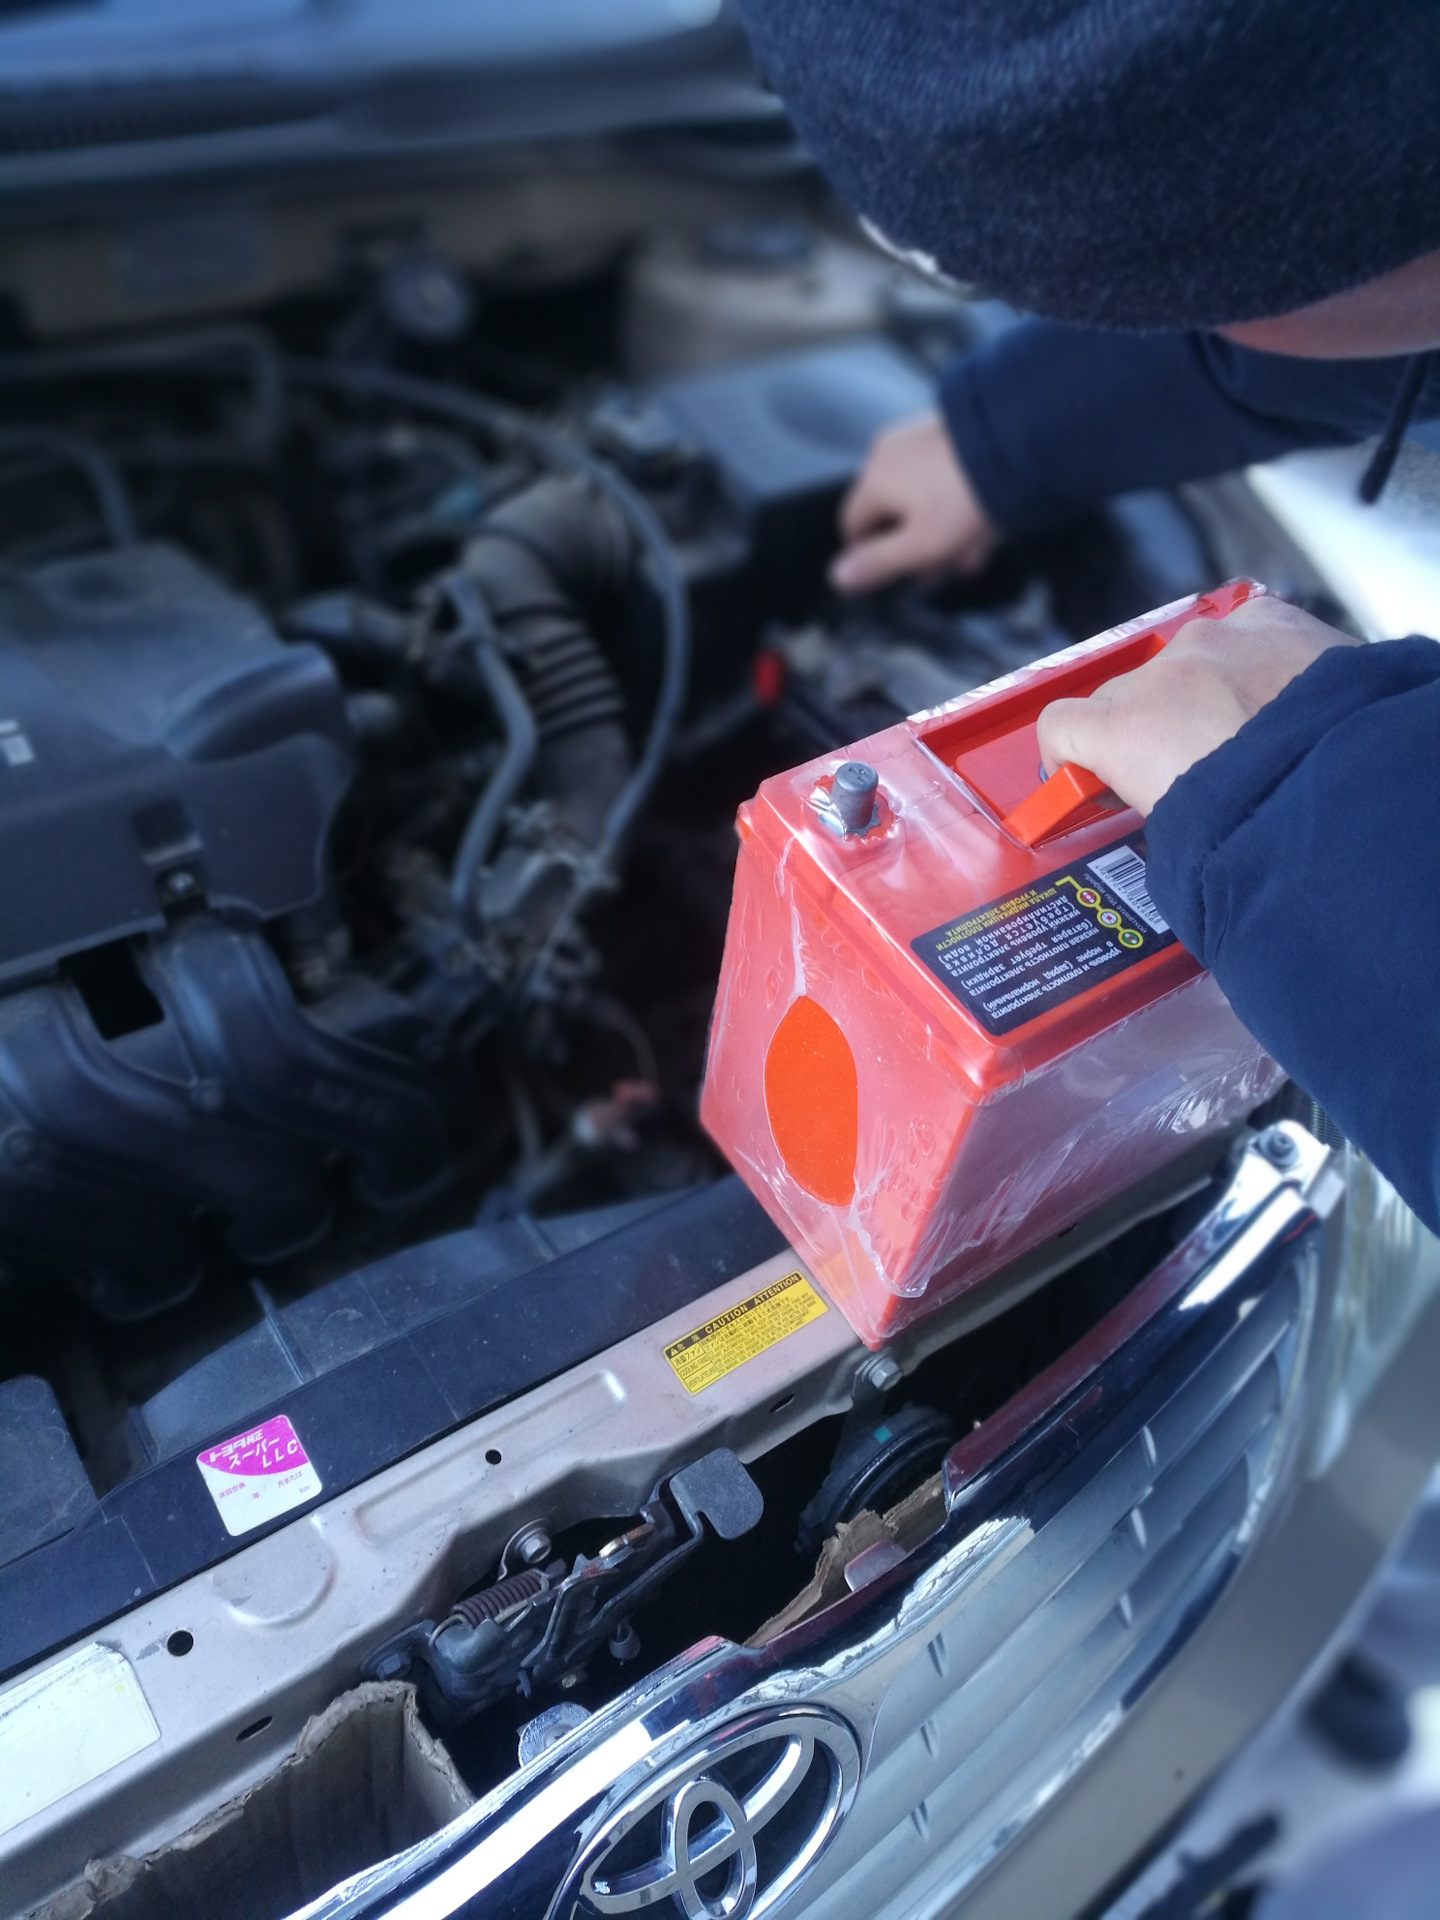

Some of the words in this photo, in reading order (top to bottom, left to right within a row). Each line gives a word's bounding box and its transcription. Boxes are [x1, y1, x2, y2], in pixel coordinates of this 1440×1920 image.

[998, 892, 1030, 911] УРОВНЯ
[1027, 887, 1057, 905] ШКАЛА
[944, 907, 1000, 937] ЭЛЕКТРОЛИТА
[980, 900, 1030, 928] ИНДИКАЦИИ
[1047, 908, 1081, 929] низкий
[935, 923, 983, 951] ПЛОТНОСТИ
[1007, 923, 1048, 947] уровень
[1049, 918, 1093, 944] (батарея
[1068, 926, 1099, 945] низкая
[937, 943, 971, 964] воды)
[943, 938, 999, 970] доливка
[949, 942, 1011, 977] электролита
[1007, 940, 1048, 965] требует
[1023, 941, 1069, 968] плотность
[1074, 945, 1102, 963] норме
[1086, 946, 1122, 968] уровень
[960, 961, 1006, 989] зарядки)
[967, 963, 1026, 997] электролита
[1040, 967, 1083, 992] плотность
[1041, 959, 1073, 980] (заряд
[1081, 963, 1090, 971] и
[981, 976, 1041, 1012] нормальный)
[989, 987, 1043, 1019] электролита
[704, 1304, 748, 1334] CAUTION
[751, 1274, 799, 1305] ATTENTION
[229, 1437, 279, 1469] スーパー
[262, 1439, 298, 1468] LLC
